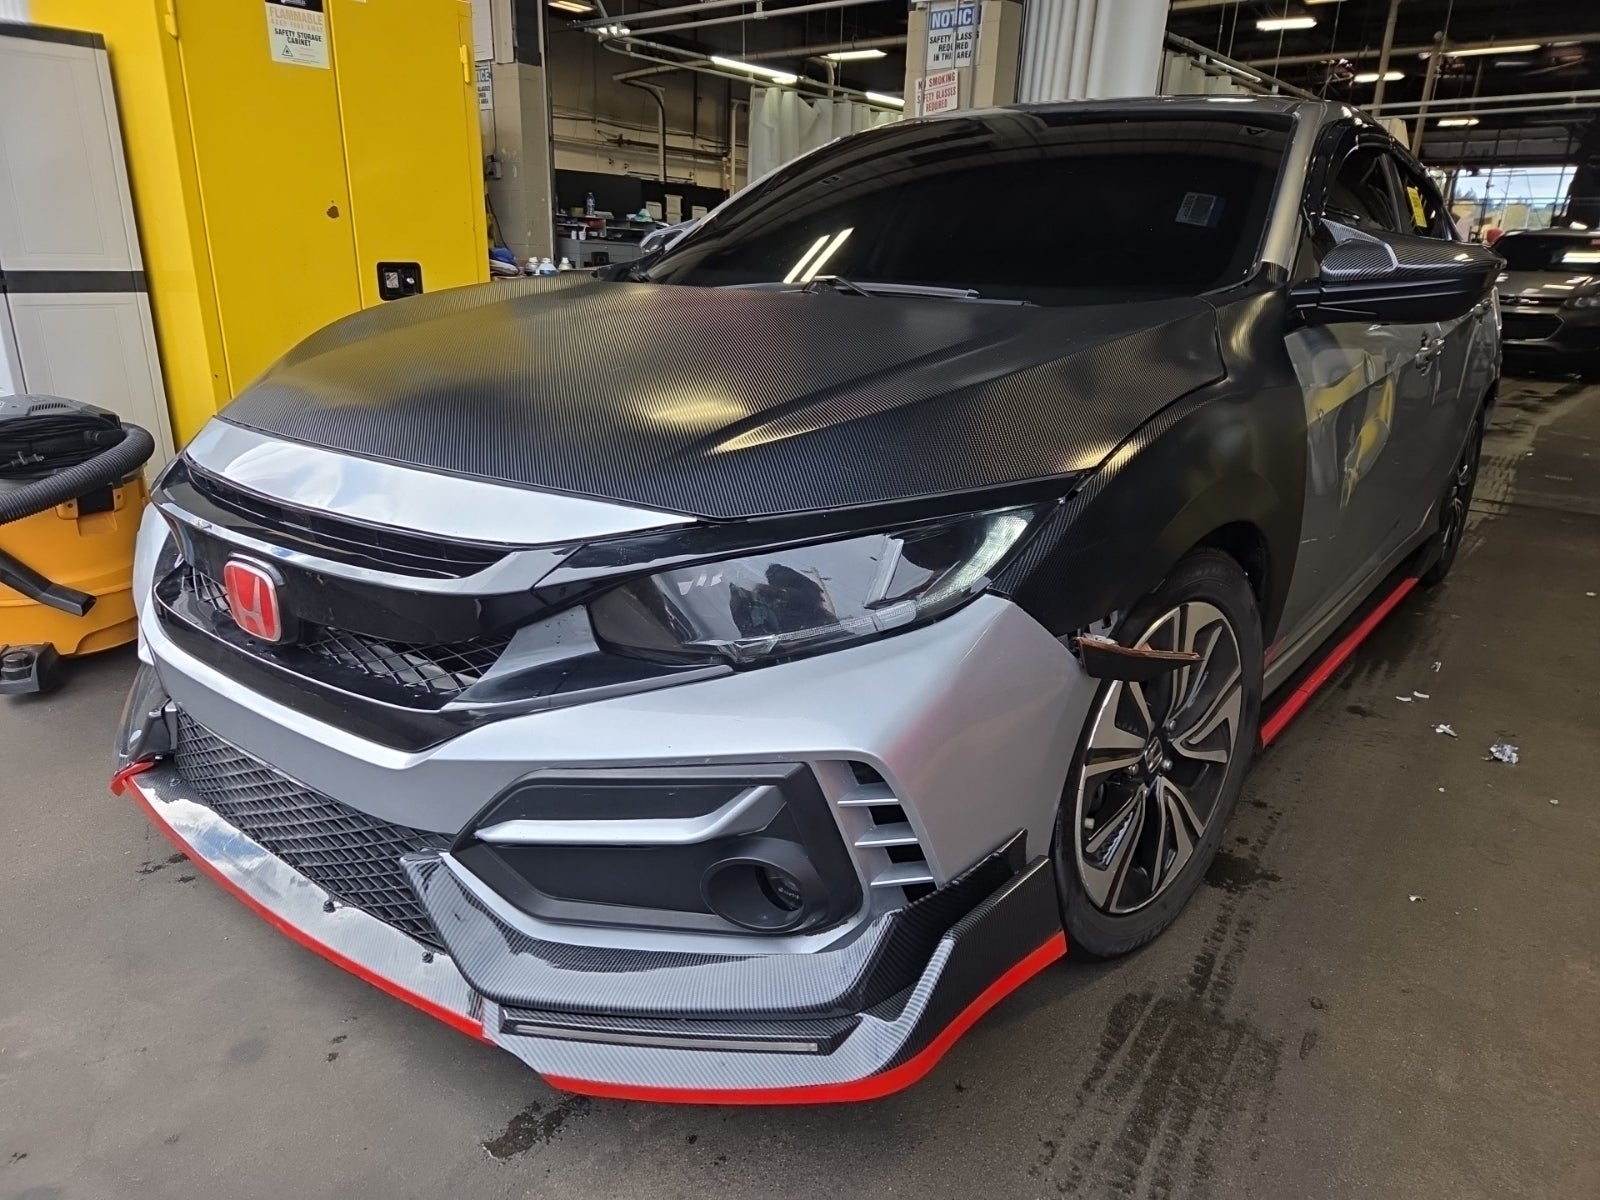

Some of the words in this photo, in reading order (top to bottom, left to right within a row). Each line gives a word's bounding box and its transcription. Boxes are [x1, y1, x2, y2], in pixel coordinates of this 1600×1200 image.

[270, 6, 323, 26] FLAMMABLE
[931, 8, 976, 29] NOTIC
[274, 28, 295, 37] SAFETY
[297, 31, 322, 42] STORAGE
[287, 37, 311, 46] CABINET
[929, 34, 951, 44] SAFETY
[933, 53, 940, 61] IN
[928, 71, 956, 87] SMOKING
[935, 86, 956, 100] GLASSES
